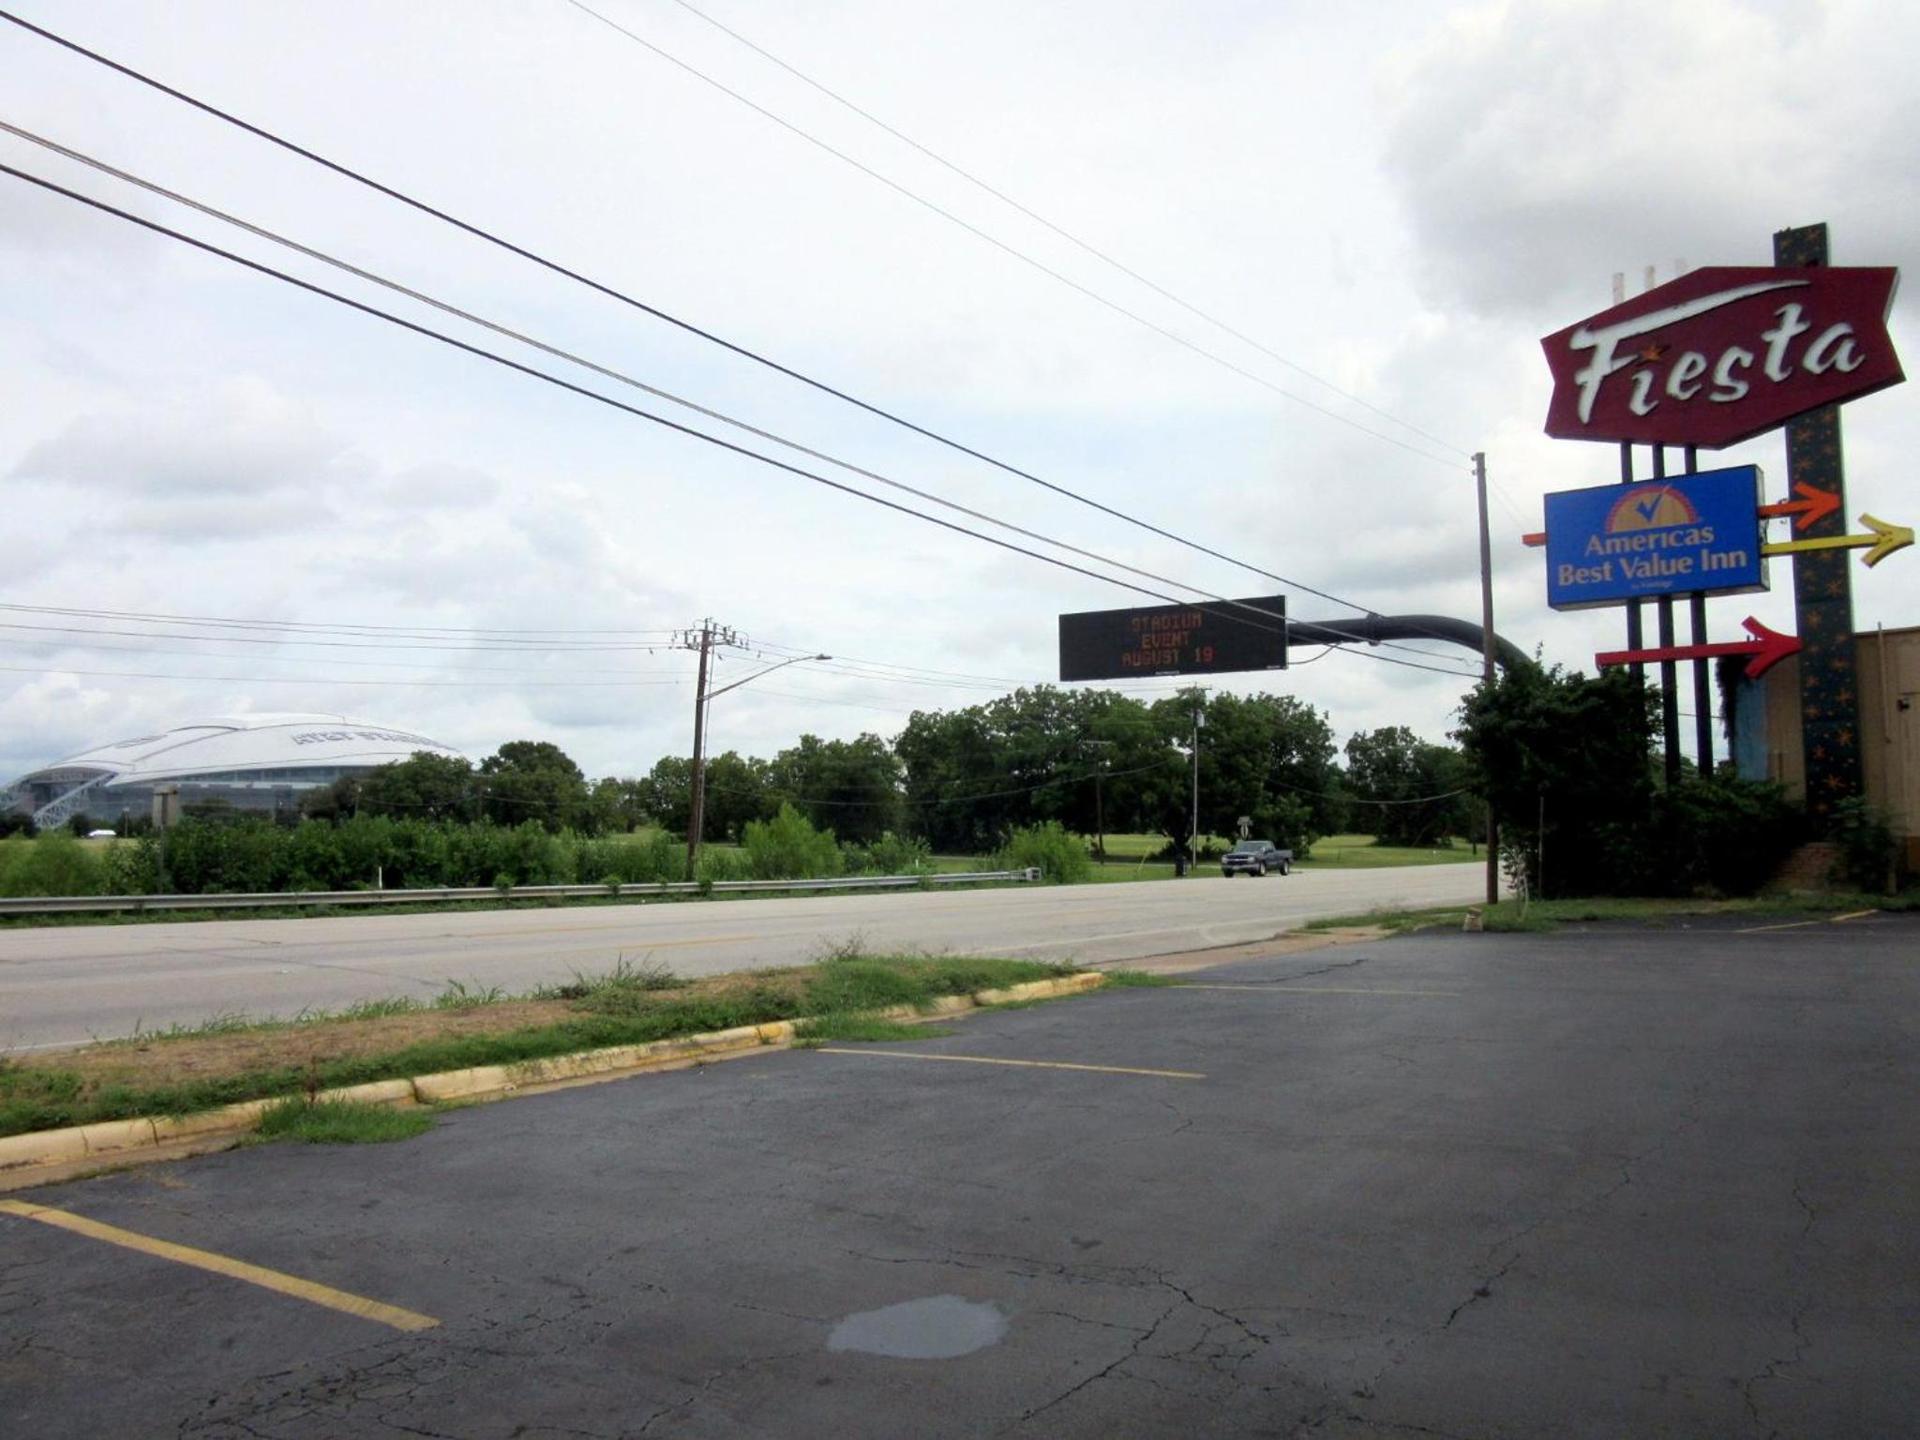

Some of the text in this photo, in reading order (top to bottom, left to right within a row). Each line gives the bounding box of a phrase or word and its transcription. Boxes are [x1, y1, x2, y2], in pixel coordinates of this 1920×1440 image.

[1570, 280, 1866, 424] Fiesta
[1585, 526, 1715, 557] Americas
[1557, 562, 1612, 586] Best
[1620, 555, 1693, 579] Value
[1702, 549, 1747, 571] Inn
[1132, 613, 1203, 632] STADIUM
[1141, 631, 1190, 649] EVENT
[1121, 647, 1213, 666] AUGUST 19
